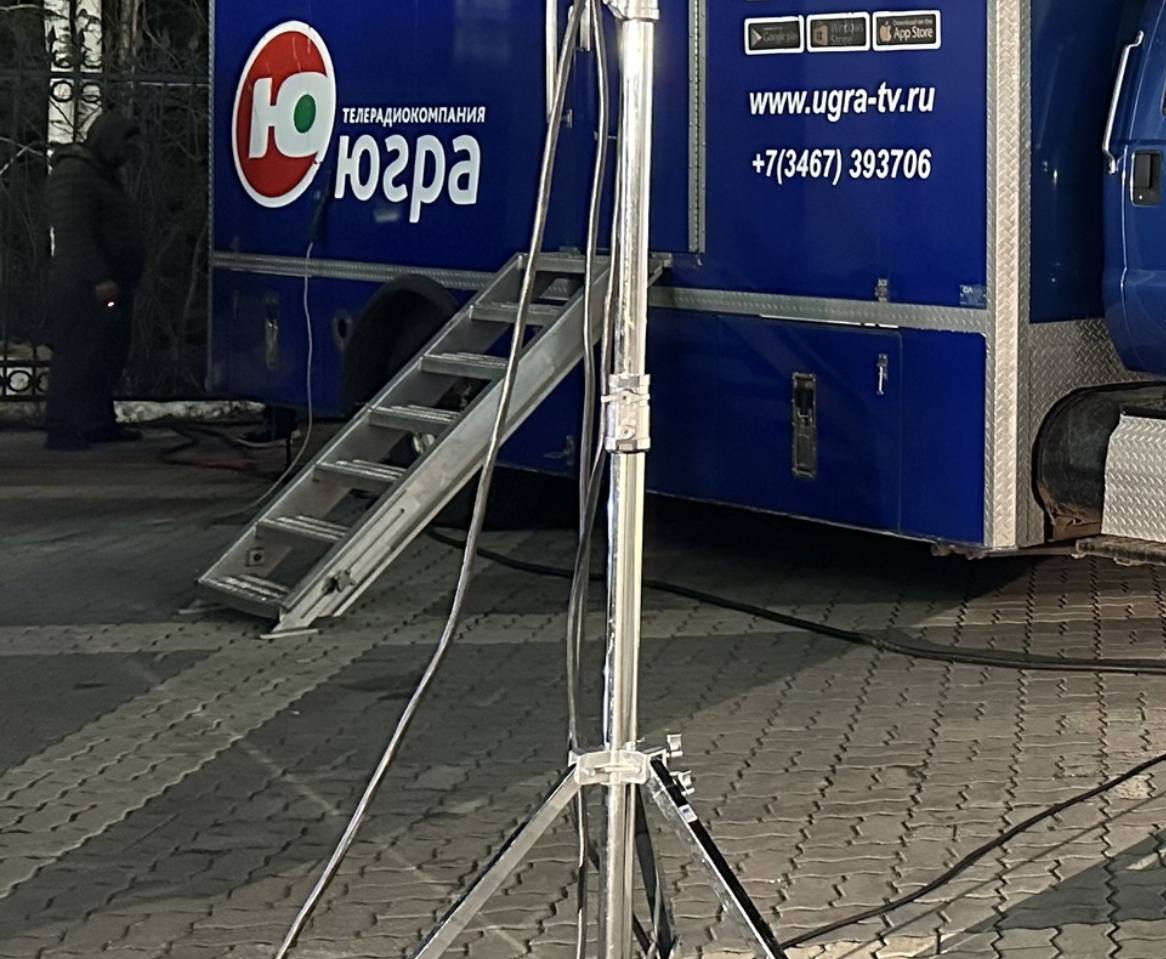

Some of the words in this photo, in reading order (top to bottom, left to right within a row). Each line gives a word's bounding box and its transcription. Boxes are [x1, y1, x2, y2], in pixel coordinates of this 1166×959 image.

[893, 27, 911, 41] App
[912, 25, 933, 39] Store
[750, 82, 935, 122] www.ugra-tv.ru
[343, 107, 486, 127] ТЕЛЕРАДИОКОМПАНИЯ
[752, 148, 842, 185] +7(3467)
[849, 148, 932, 179] 393706
